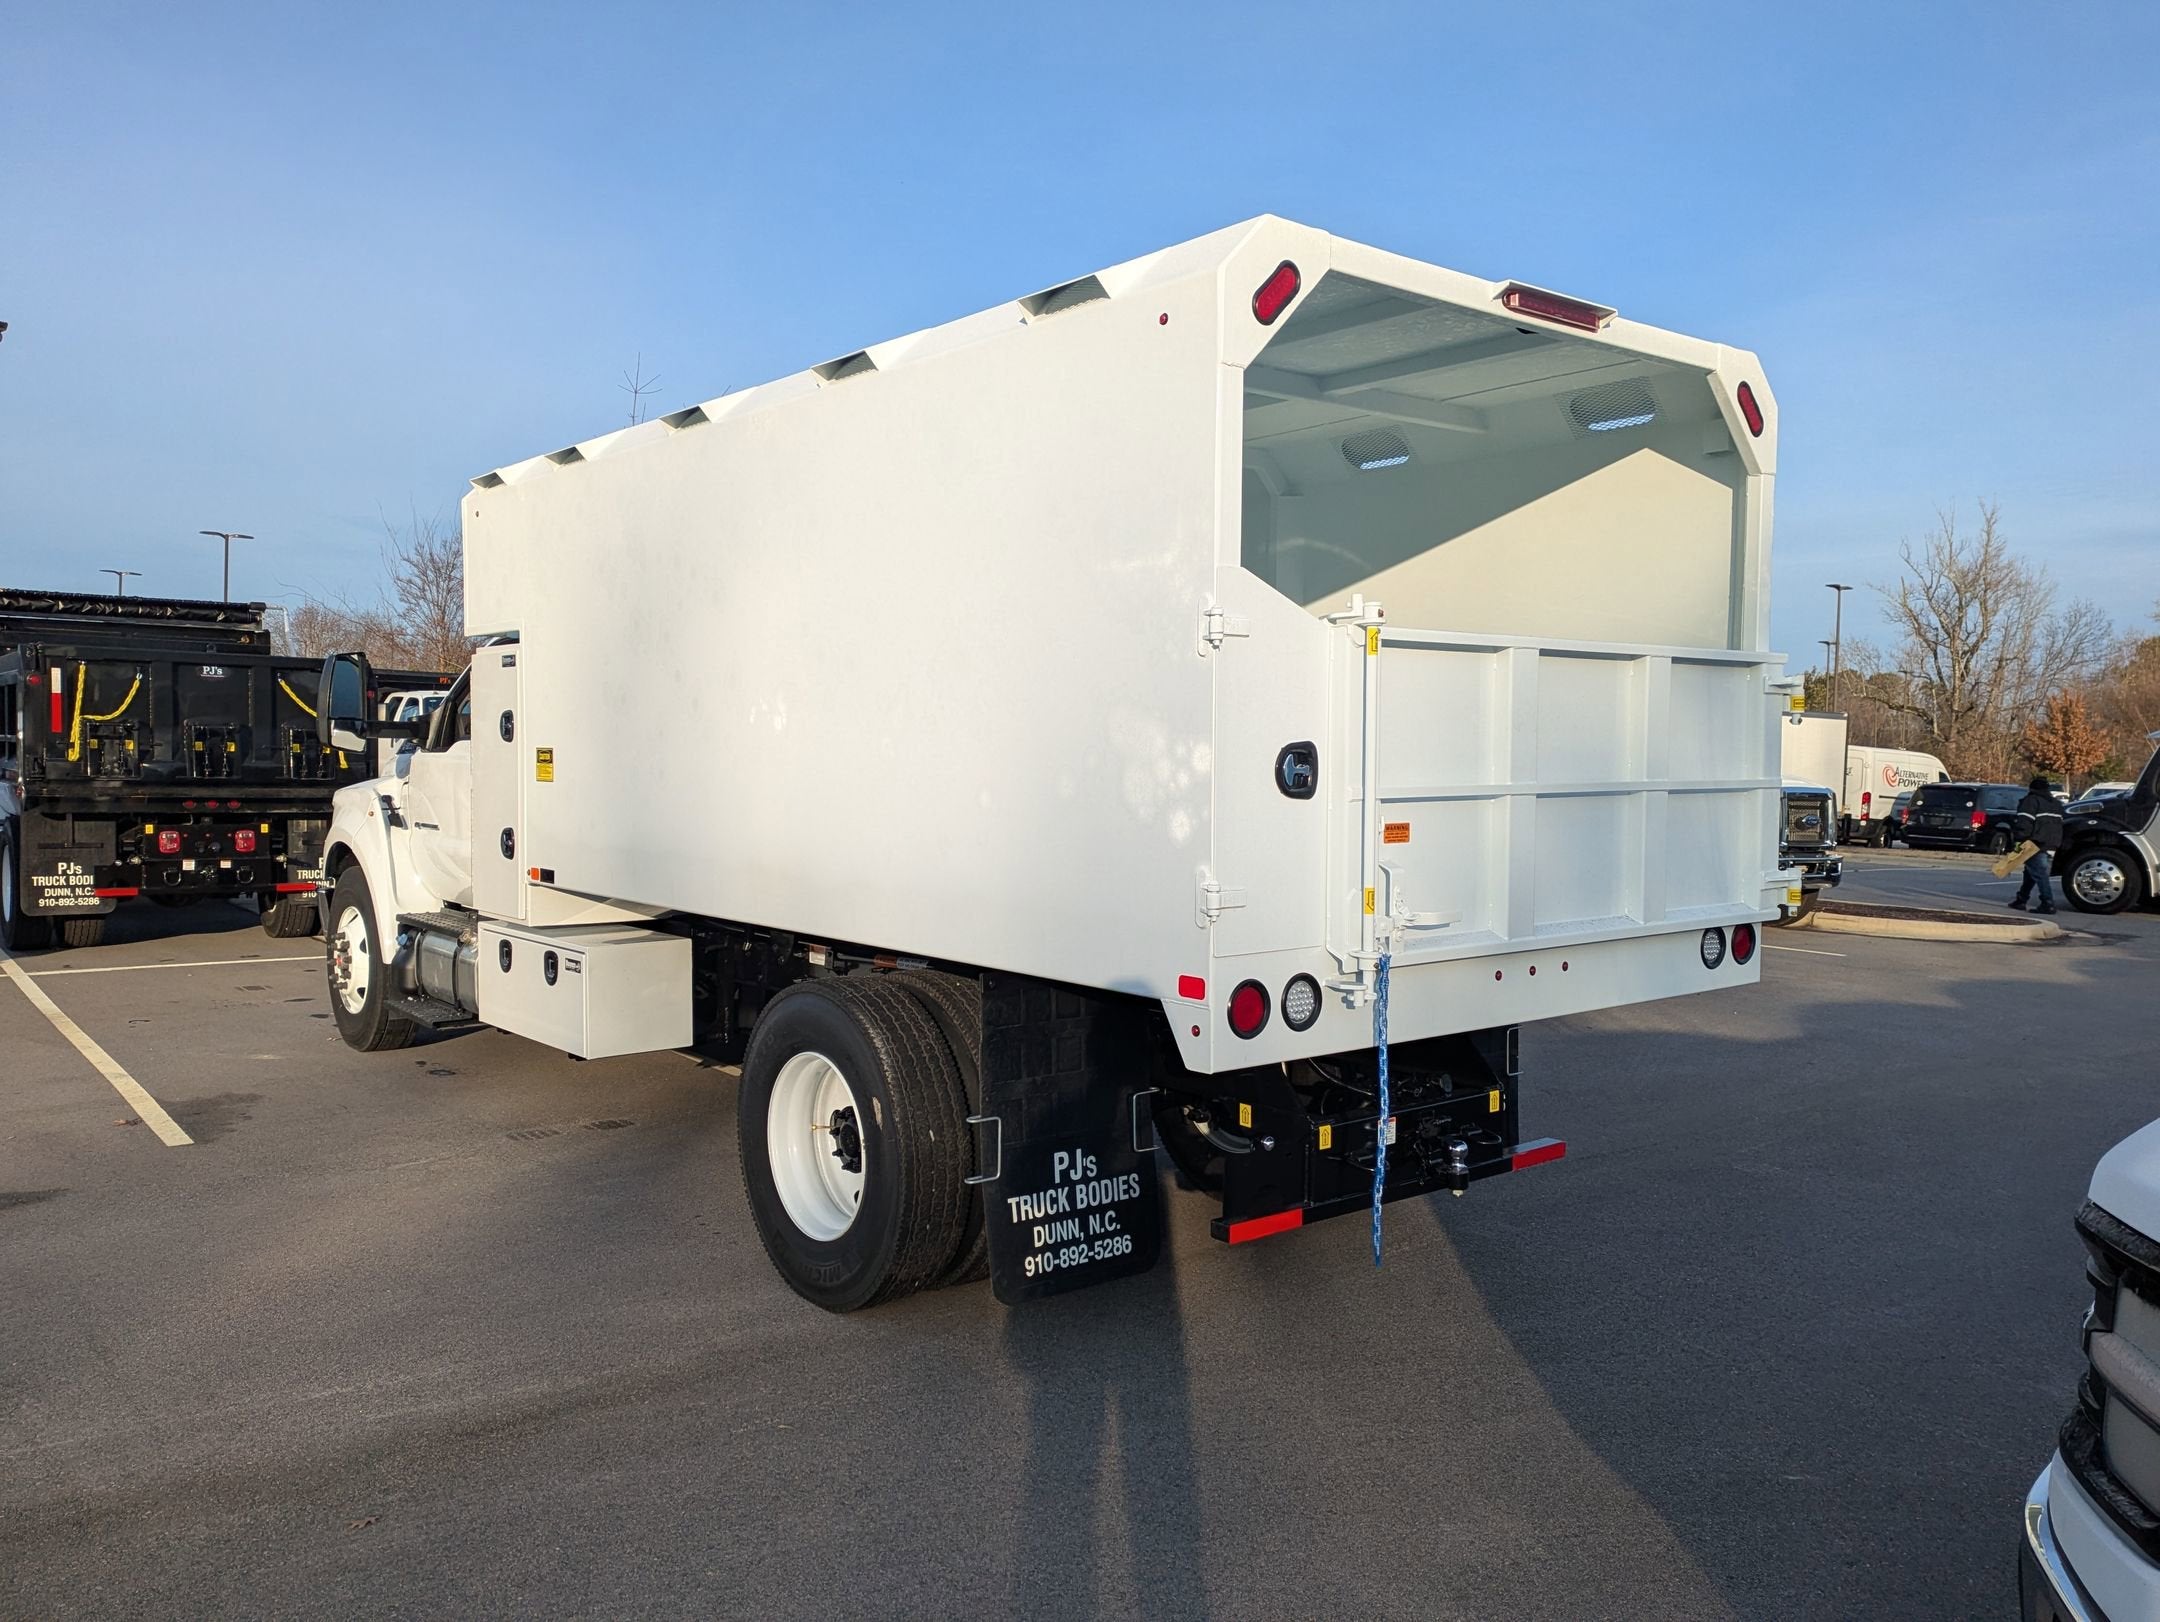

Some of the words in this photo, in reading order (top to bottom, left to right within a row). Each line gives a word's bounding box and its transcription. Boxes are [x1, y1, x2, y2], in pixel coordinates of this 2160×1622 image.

[202, 665, 223, 675] PJ's
[57, 862, 82, 875] PJ's
[31, 875, 66, 887] TRUCK
[69, 875, 94, 886] BODI
[44, 888, 74, 898] DUNN,
[38, 897, 100, 907] 910-892-5286
[1053, 1148, 1098, 1184] PJ's
[1007, 1187, 1070, 1223] TRUCK
[1075, 1173, 1141, 1210] BODIES
[1033, 1217, 1085, 1248] DUNN,
[1088, 1210, 1121, 1236] N.C.
[1024, 1234, 1132, 1277] 910-892-5286
